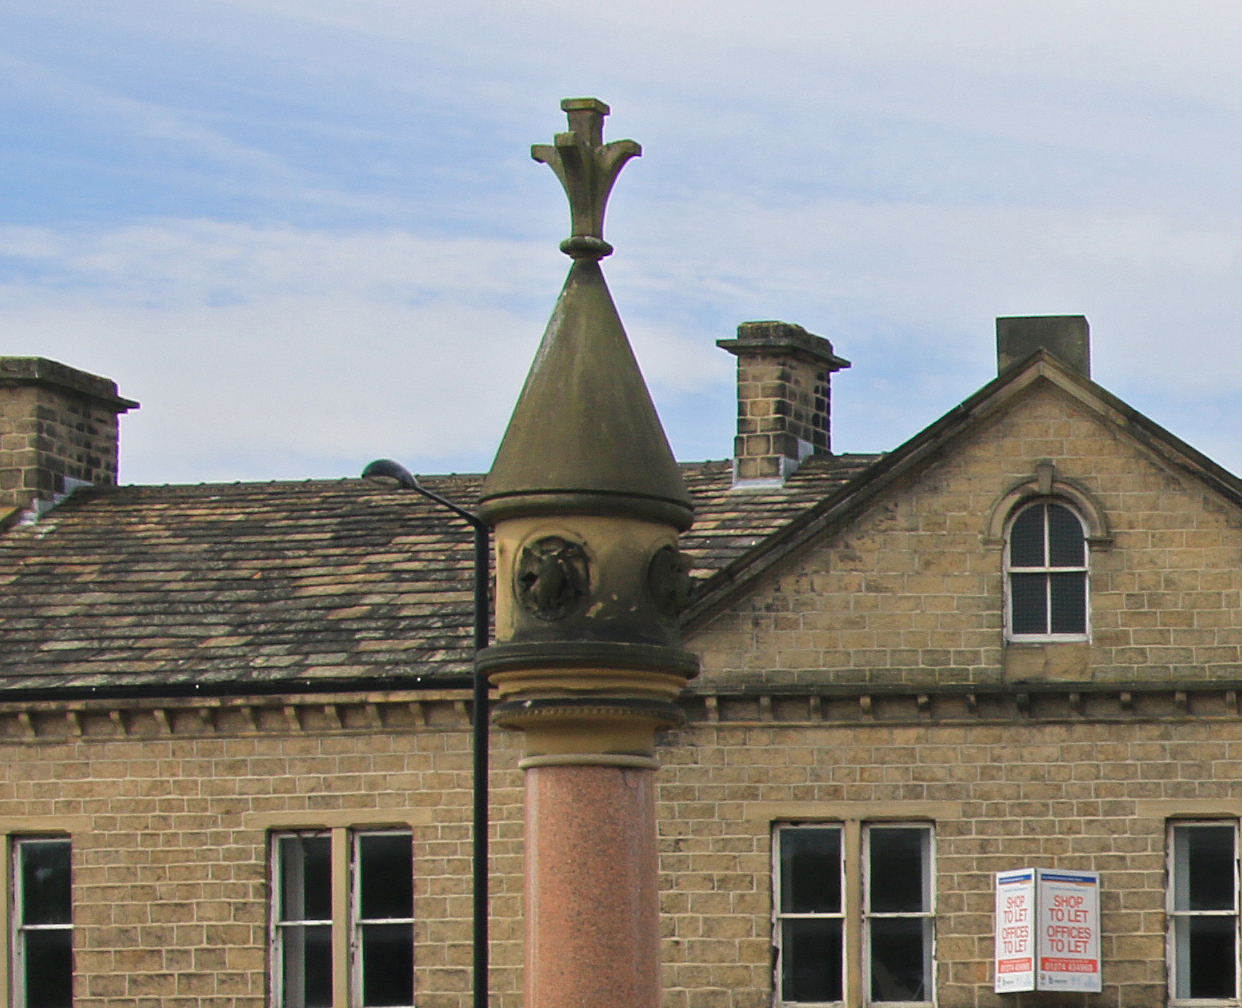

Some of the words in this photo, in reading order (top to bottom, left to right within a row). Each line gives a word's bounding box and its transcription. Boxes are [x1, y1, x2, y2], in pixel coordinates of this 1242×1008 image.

[1006, 895, 1025, 909] SHOP
[1054, 895, 1084, 908] SHOP
[1003, 910, 1013, 923] TO
[1014, 908, 1028, 923] LET
[1048, 908, 1064, 922] TO
[1068, 909, 1089, 923] LET
[1002, 926, 1028, 940] OFFICES
[1046, 925, 1092, 940] OFFICES
[1003, 940, 1013, 954] TO
[1014, 939, 1028, 953] LET
[1049, 939, 1064, 953] TO
[1068, 940, 1089, 954] LET
